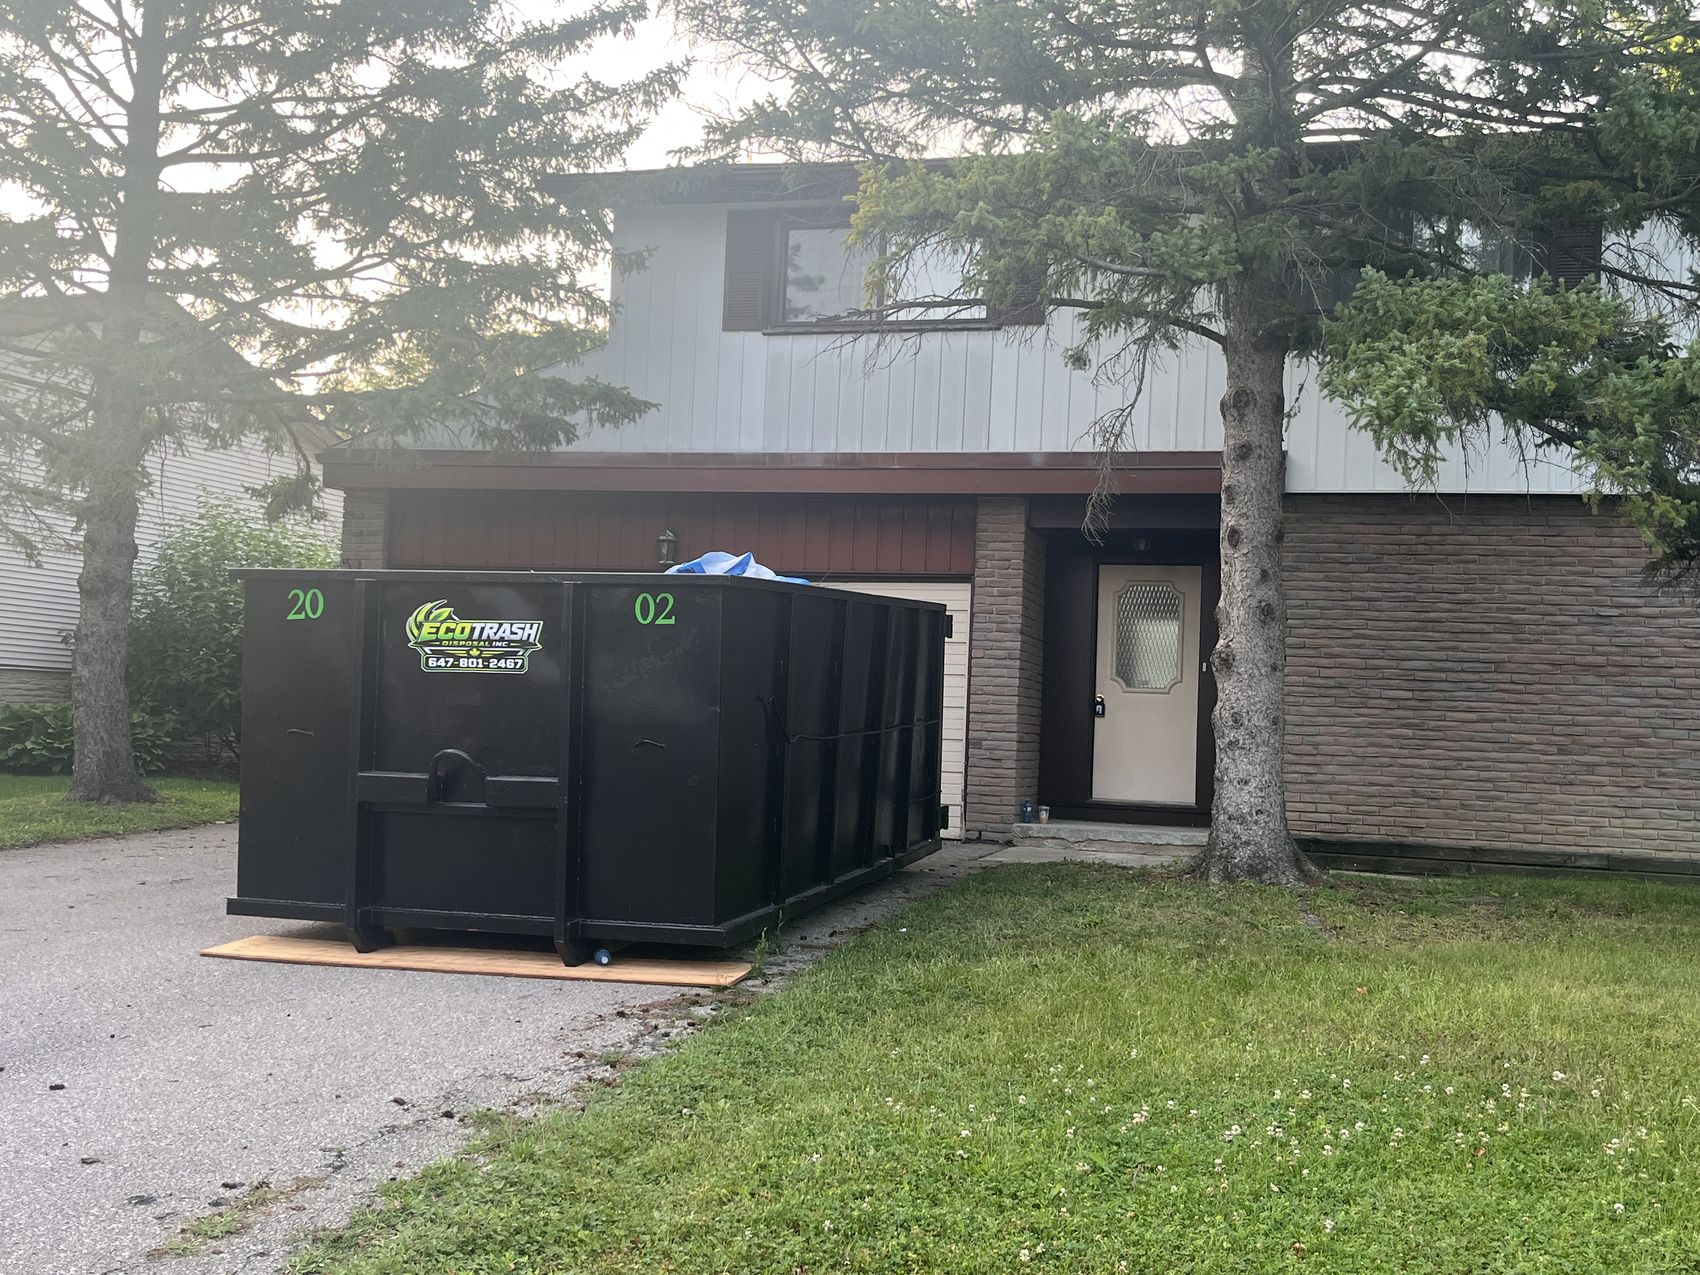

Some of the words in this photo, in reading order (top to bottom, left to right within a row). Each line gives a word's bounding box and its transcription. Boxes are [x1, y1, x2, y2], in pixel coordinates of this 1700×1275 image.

[287, 588, 325, 620] 20
[634, 592, 676, 625] 02
[418, 622, 539, 643] ECOTRASH
[428, 657, 523, 669] 647-801-2467
